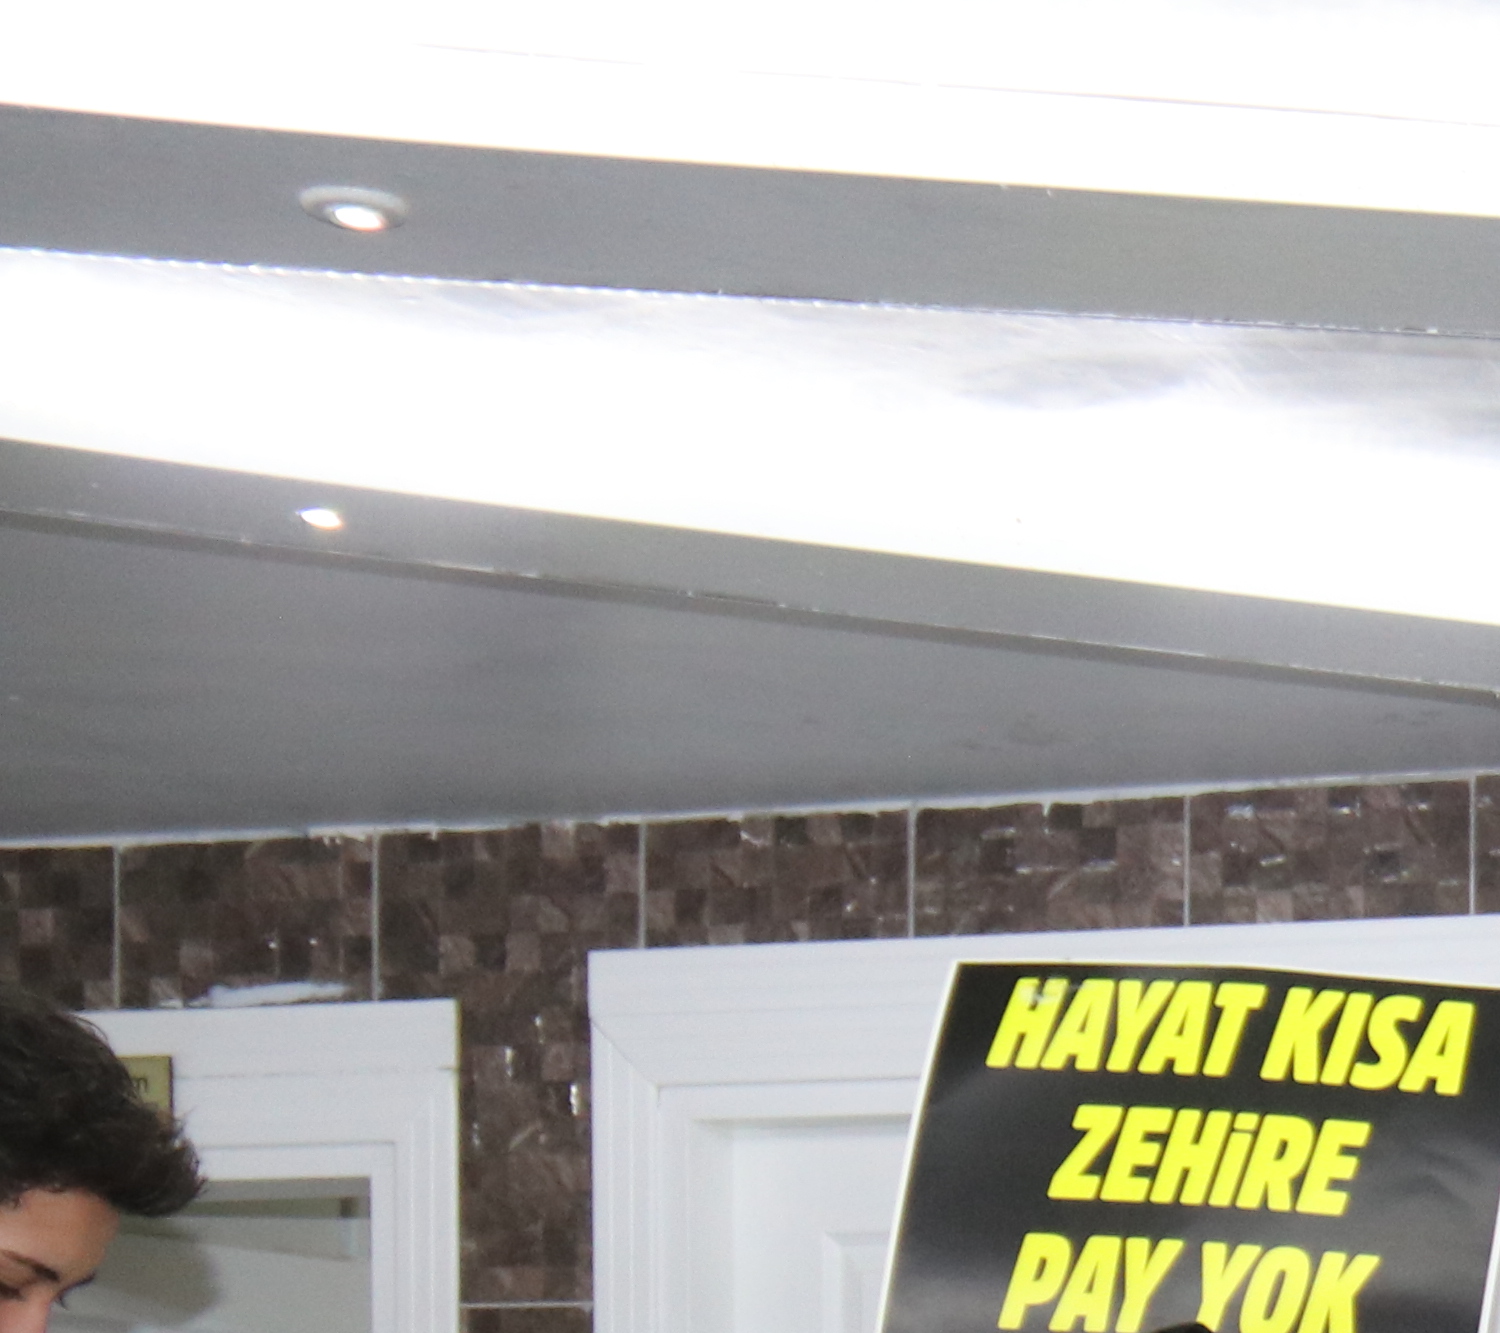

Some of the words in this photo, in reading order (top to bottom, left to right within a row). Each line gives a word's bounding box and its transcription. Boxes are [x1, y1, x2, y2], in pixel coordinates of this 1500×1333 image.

[986, 977, 1266, 1077] HAYAT
[1260, 986, 1475, 1095] KISA
[1047, 1104, 1371, 1216] ZEHİRE
[997, 1232, 1183, 1333] PAY
